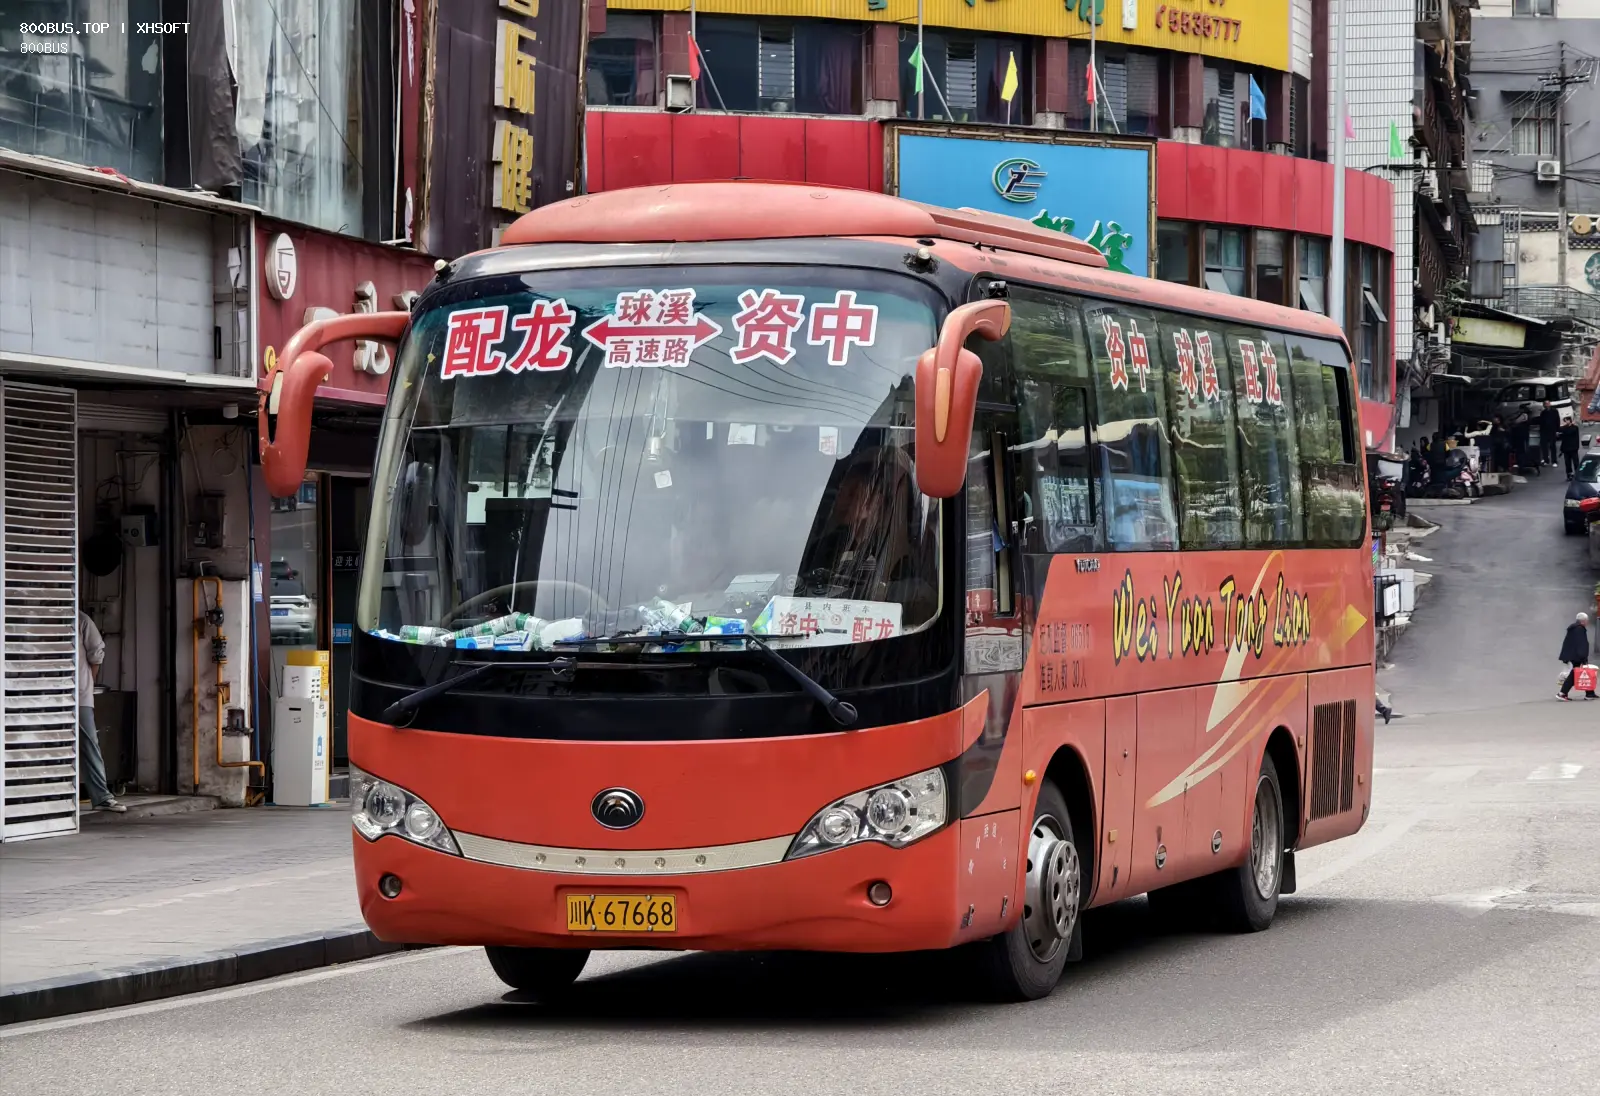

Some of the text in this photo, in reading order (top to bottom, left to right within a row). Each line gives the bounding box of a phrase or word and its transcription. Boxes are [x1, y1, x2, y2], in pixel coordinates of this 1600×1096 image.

[1168, 9, 1242, 42] 5535777
[617, 290, 692, 326] 球溪
[442, 301, 575, 378] 配龙
[734, 291, 875, 364] 资中
[608, 338, 690, 364] 高速路
[1102, 315, 1281, 405] 资中 球溪 配龙
[803, 601, 870, 614] 县内班车
[1113, 568, 1311, 667] Wei Yuan Tong Lian
[851, 616, 895, 643] 配龙
